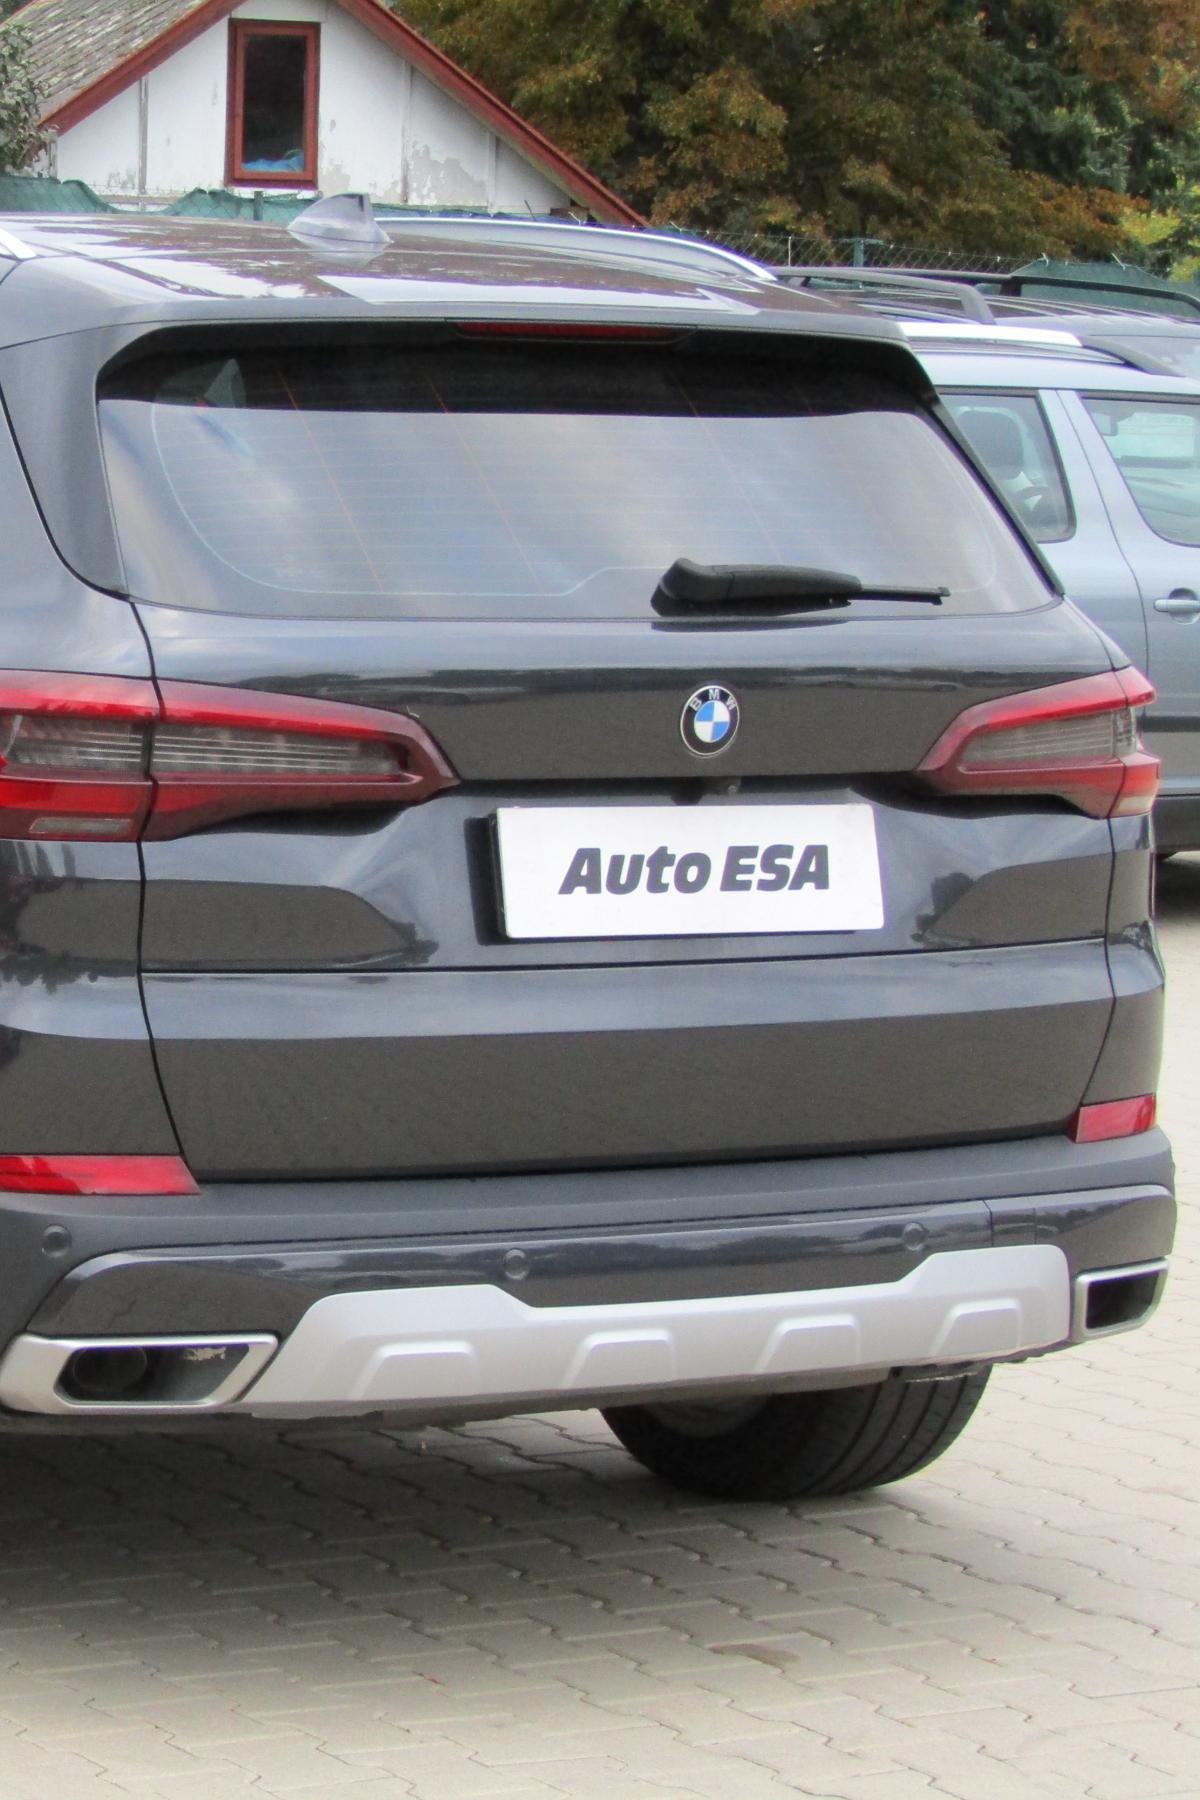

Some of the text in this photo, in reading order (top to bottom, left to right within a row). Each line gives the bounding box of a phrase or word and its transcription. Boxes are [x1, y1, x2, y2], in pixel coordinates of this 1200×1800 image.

[689, 688, 737, 711] BMW
[558, 844, 829, 893] Auto ESA
